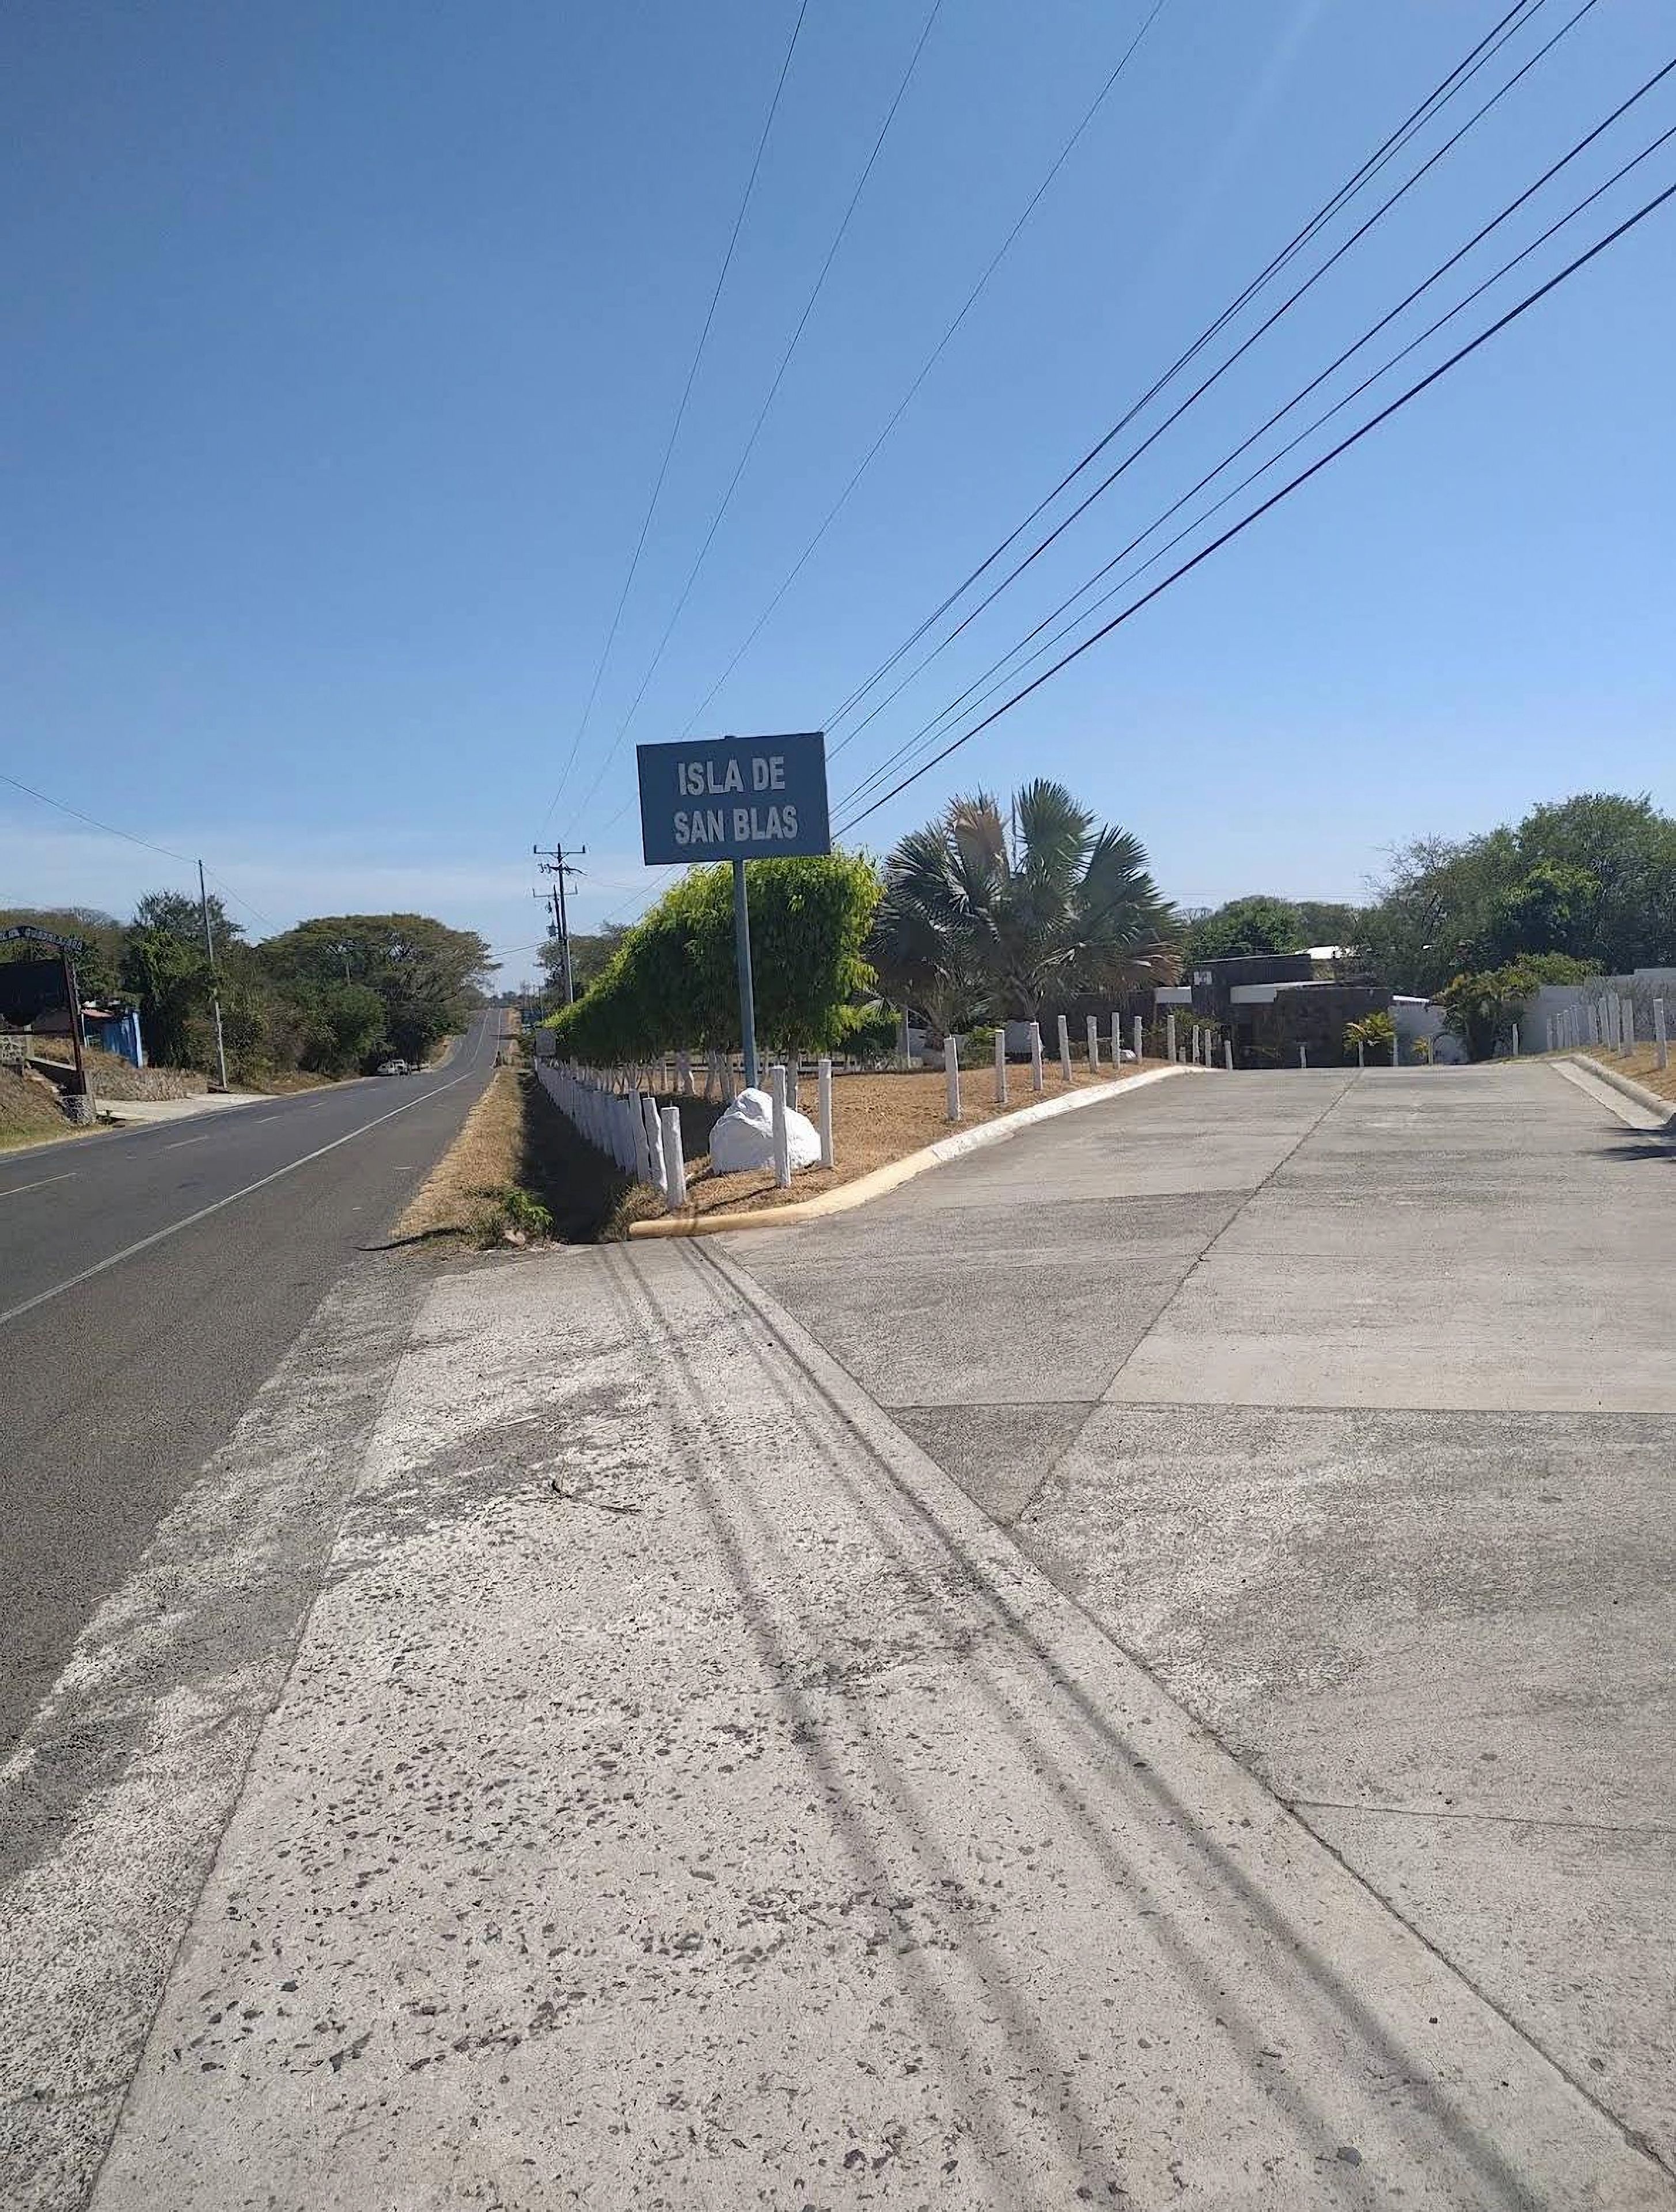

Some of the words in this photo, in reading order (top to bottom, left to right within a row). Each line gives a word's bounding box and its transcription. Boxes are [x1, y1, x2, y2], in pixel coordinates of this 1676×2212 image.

[678, 759, 744, 796] ISLA
[752, 756, 785, 790] DE
[674, 809, 725, 844] SAN
[733, 806, 798, 842] BLAS
